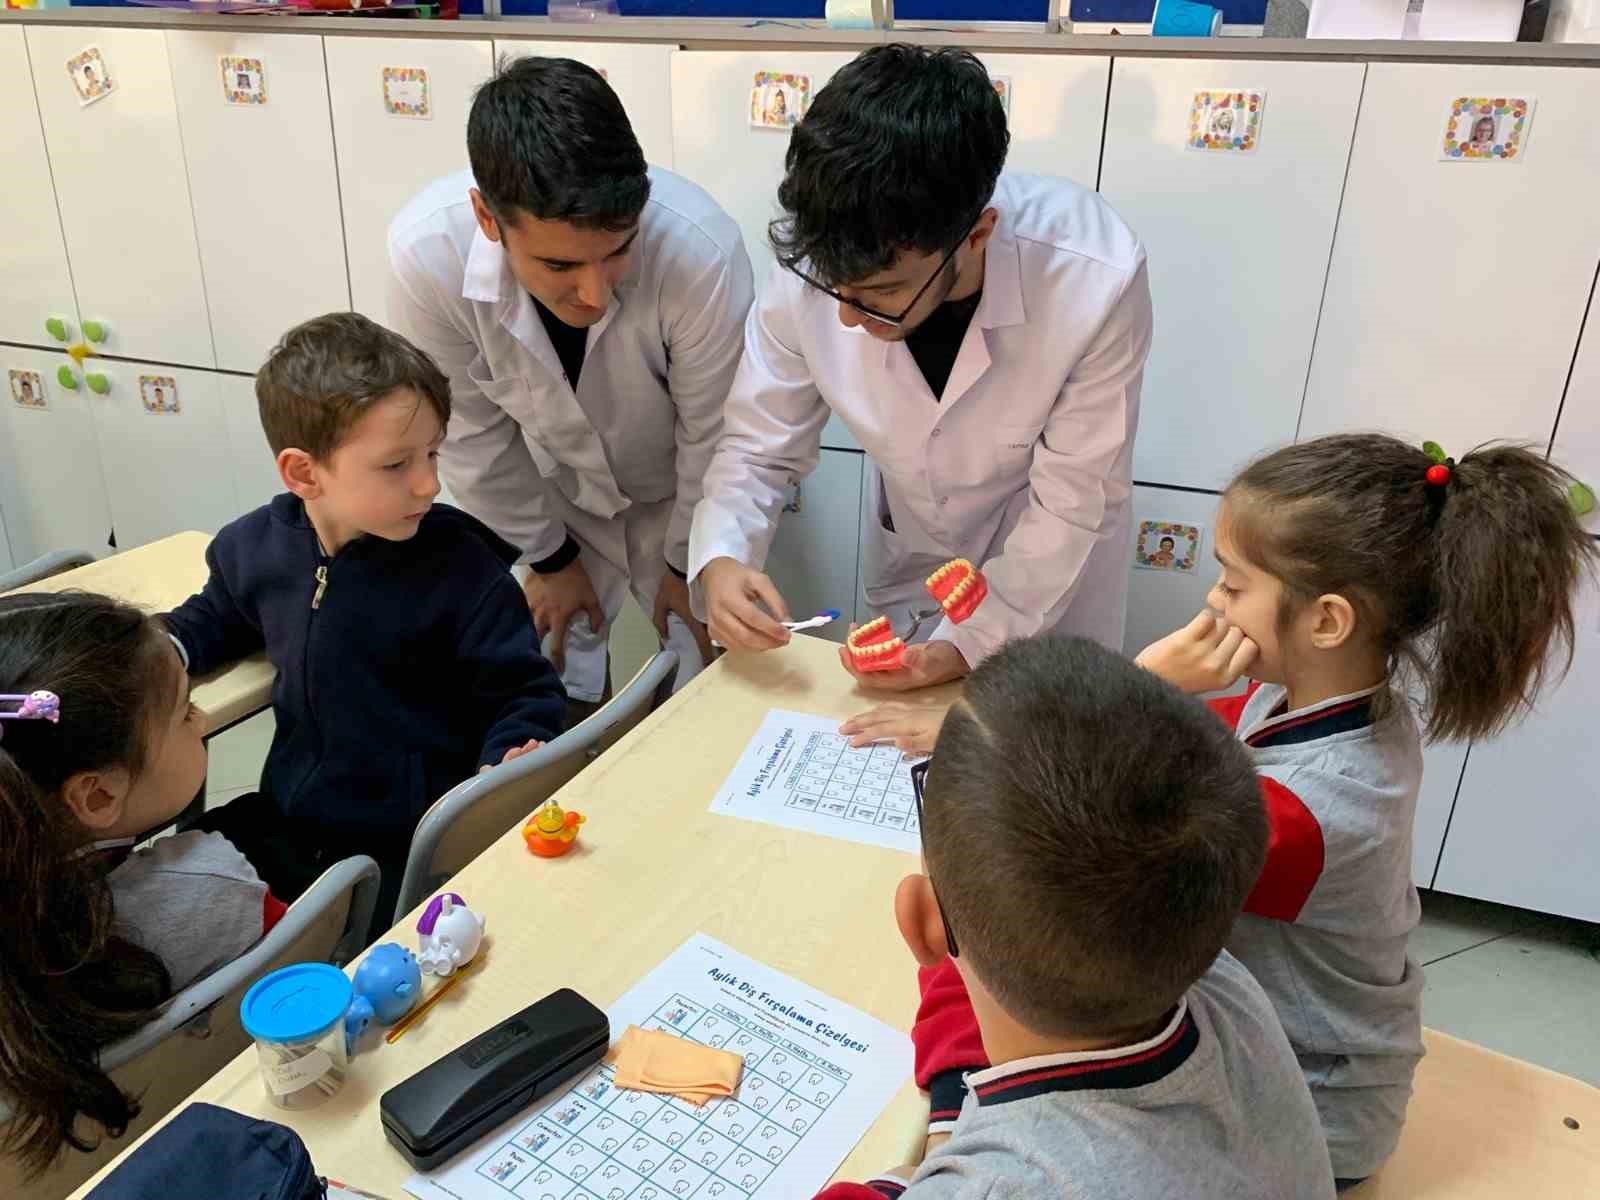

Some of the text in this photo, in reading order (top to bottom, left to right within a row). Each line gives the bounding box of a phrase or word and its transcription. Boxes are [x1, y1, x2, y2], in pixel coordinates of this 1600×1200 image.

[707, 967, 738, 987] Aylık
[738, 981, 757, 998] Diş
[758, 991, 813, 1027] Fırçalama
[815, 1023, 870, 1053] Çizelgesi
